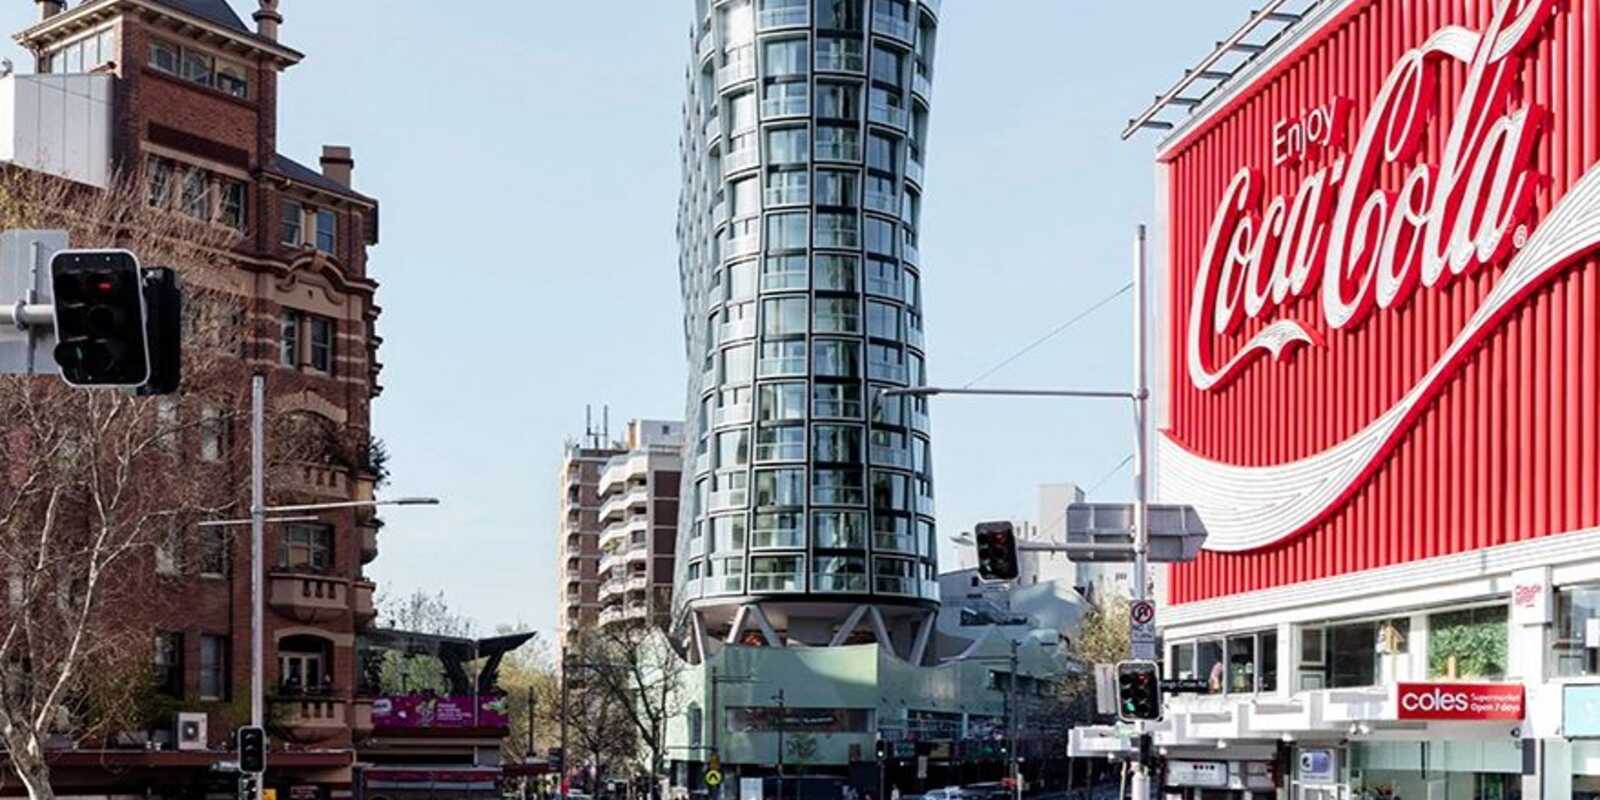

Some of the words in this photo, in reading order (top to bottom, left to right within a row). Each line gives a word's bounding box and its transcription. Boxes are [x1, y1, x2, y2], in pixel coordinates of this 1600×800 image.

[1272, 95, 1336, 166] Enjoy
[1402, 687, 1469, 711] coles
[1470, 702, 1494, 714] Open
[1501, 702, 1521, 714] days
